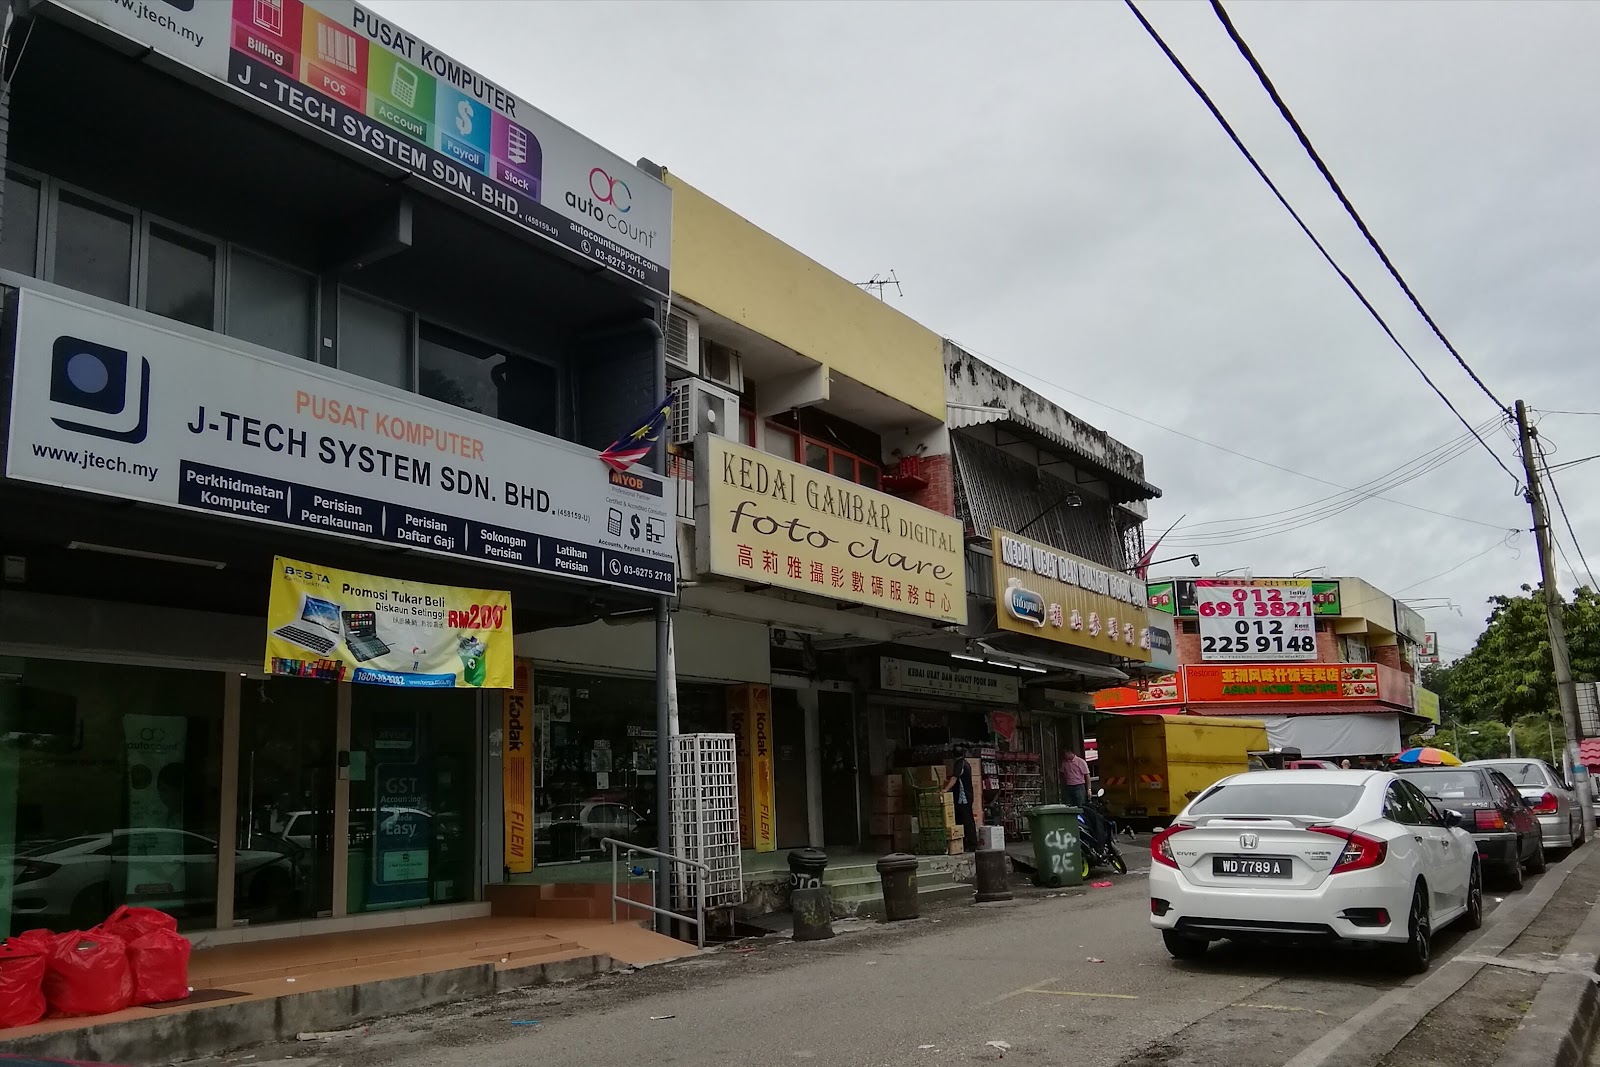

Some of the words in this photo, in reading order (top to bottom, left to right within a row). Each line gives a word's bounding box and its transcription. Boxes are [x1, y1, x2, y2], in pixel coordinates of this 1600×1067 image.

[108, 0, 204, 47] w.jtech.my
[247, 36, 284, 66] Billing
[353, 7, 415, 58] PUSAT
[421, 46, 516, 118] KOMPUTER
[323, 75, 347, 96] POS
[378, 106, 423, 136] Account
[274, 79, 336, 127] TECH
[342, 114, 426, 172] SYSTEM
[433, 161, 476, 197] SDN.
[482, 184, 523, 219] BHD.
[447, 139, 480, 166] Payroll
[504, 170, 529, 191] Stock
[570, 222, 658, 273] autocountsupport.com
[595, 248, 625, 270] 03-6275
[628, 263, 645, 280] 2718
[296, 391, 368, 431] PUSAT
[376, 415, 484, 461] KOMPUTER
[32, 443, 158, 482] www.jtech.my
[187, 406, 306, 458] J-TECH
[318, 436, 431, 488] SYSTEM
[440, 466, 496, 501] SDN.
[505, 481, 557, 515] BHD.
[186, 470, 284, 500] Perkhidmatan
[612, 474, 644, 489] MYOB
[201, 491, 271, 515] Komputer
[314, 495, 362, 515] Perisian
[723, 451, 796, 505] KEDAI
[806, 480, 891, 534] GAMBAR
[900, 518, 956, 554] DIGITAL
[301, 509, 373, 534] Perakaunan
[405, 513, 447, 532] Perisian
[397, 528, 431, 546] Daftar
[434, 533, 455, 549] Gaji
[480, 529, 526, 548] Sokongan
[730, 501, 839, 549] foto
[847, 537, 953, 581] clare
[485, 545, 522, 561] Perisian
[556, 545, 587, 559] Latihan
[1002, 535, 1034, 572] KEDAI
[1033, 547, 1058, 579] UBAT
[1058, 556, 1079, 586] DAN
[555, 558, 588, 573] Perisian
[623, 564, 653, 579] 03-6275
[655, 570, 672, 582] 2718
[737, 543, 952, 613] 高莉雅攝影數碼服務中心
[342, 583, 388, 601] Promosi
[392, 591, 422, 605] Tukar
[425, 596, 445, 607] Beli
[1232, 589, 1283, 601] 012
[375, 602, 408, 615] Diskaun
[411, 607, 445, 620] Setinggi
[1199, 602, 1245, 616] 691
[1254, 602, 1312, 616] 3821
[1235, 620, 1284, 634] 012
[1202, 636, 1249, 652] 225
[1256, 635, 1315, 652] 9148
[1188, 669, 1219, 677] Restoran
[1222, 684, 1257, 695] ASIAN
[1261, 684, 1294, 694] HOME
[1297, 683, 1338, 694] RECIPE
[509, 695, 524, 752] Kodak
[756, 712, 767, 757] Kodak
[385, 777, 418, 793] GST
[386, 821, 416, 837] Easy
[761, 803, 769, 840] FILEM
[511, 811, 524, 857] FILEM
[1223, 860, 1238, 872] WD
[1241, 860, 1270, 873] 7789
[1273, 862, 1281, 874] A
